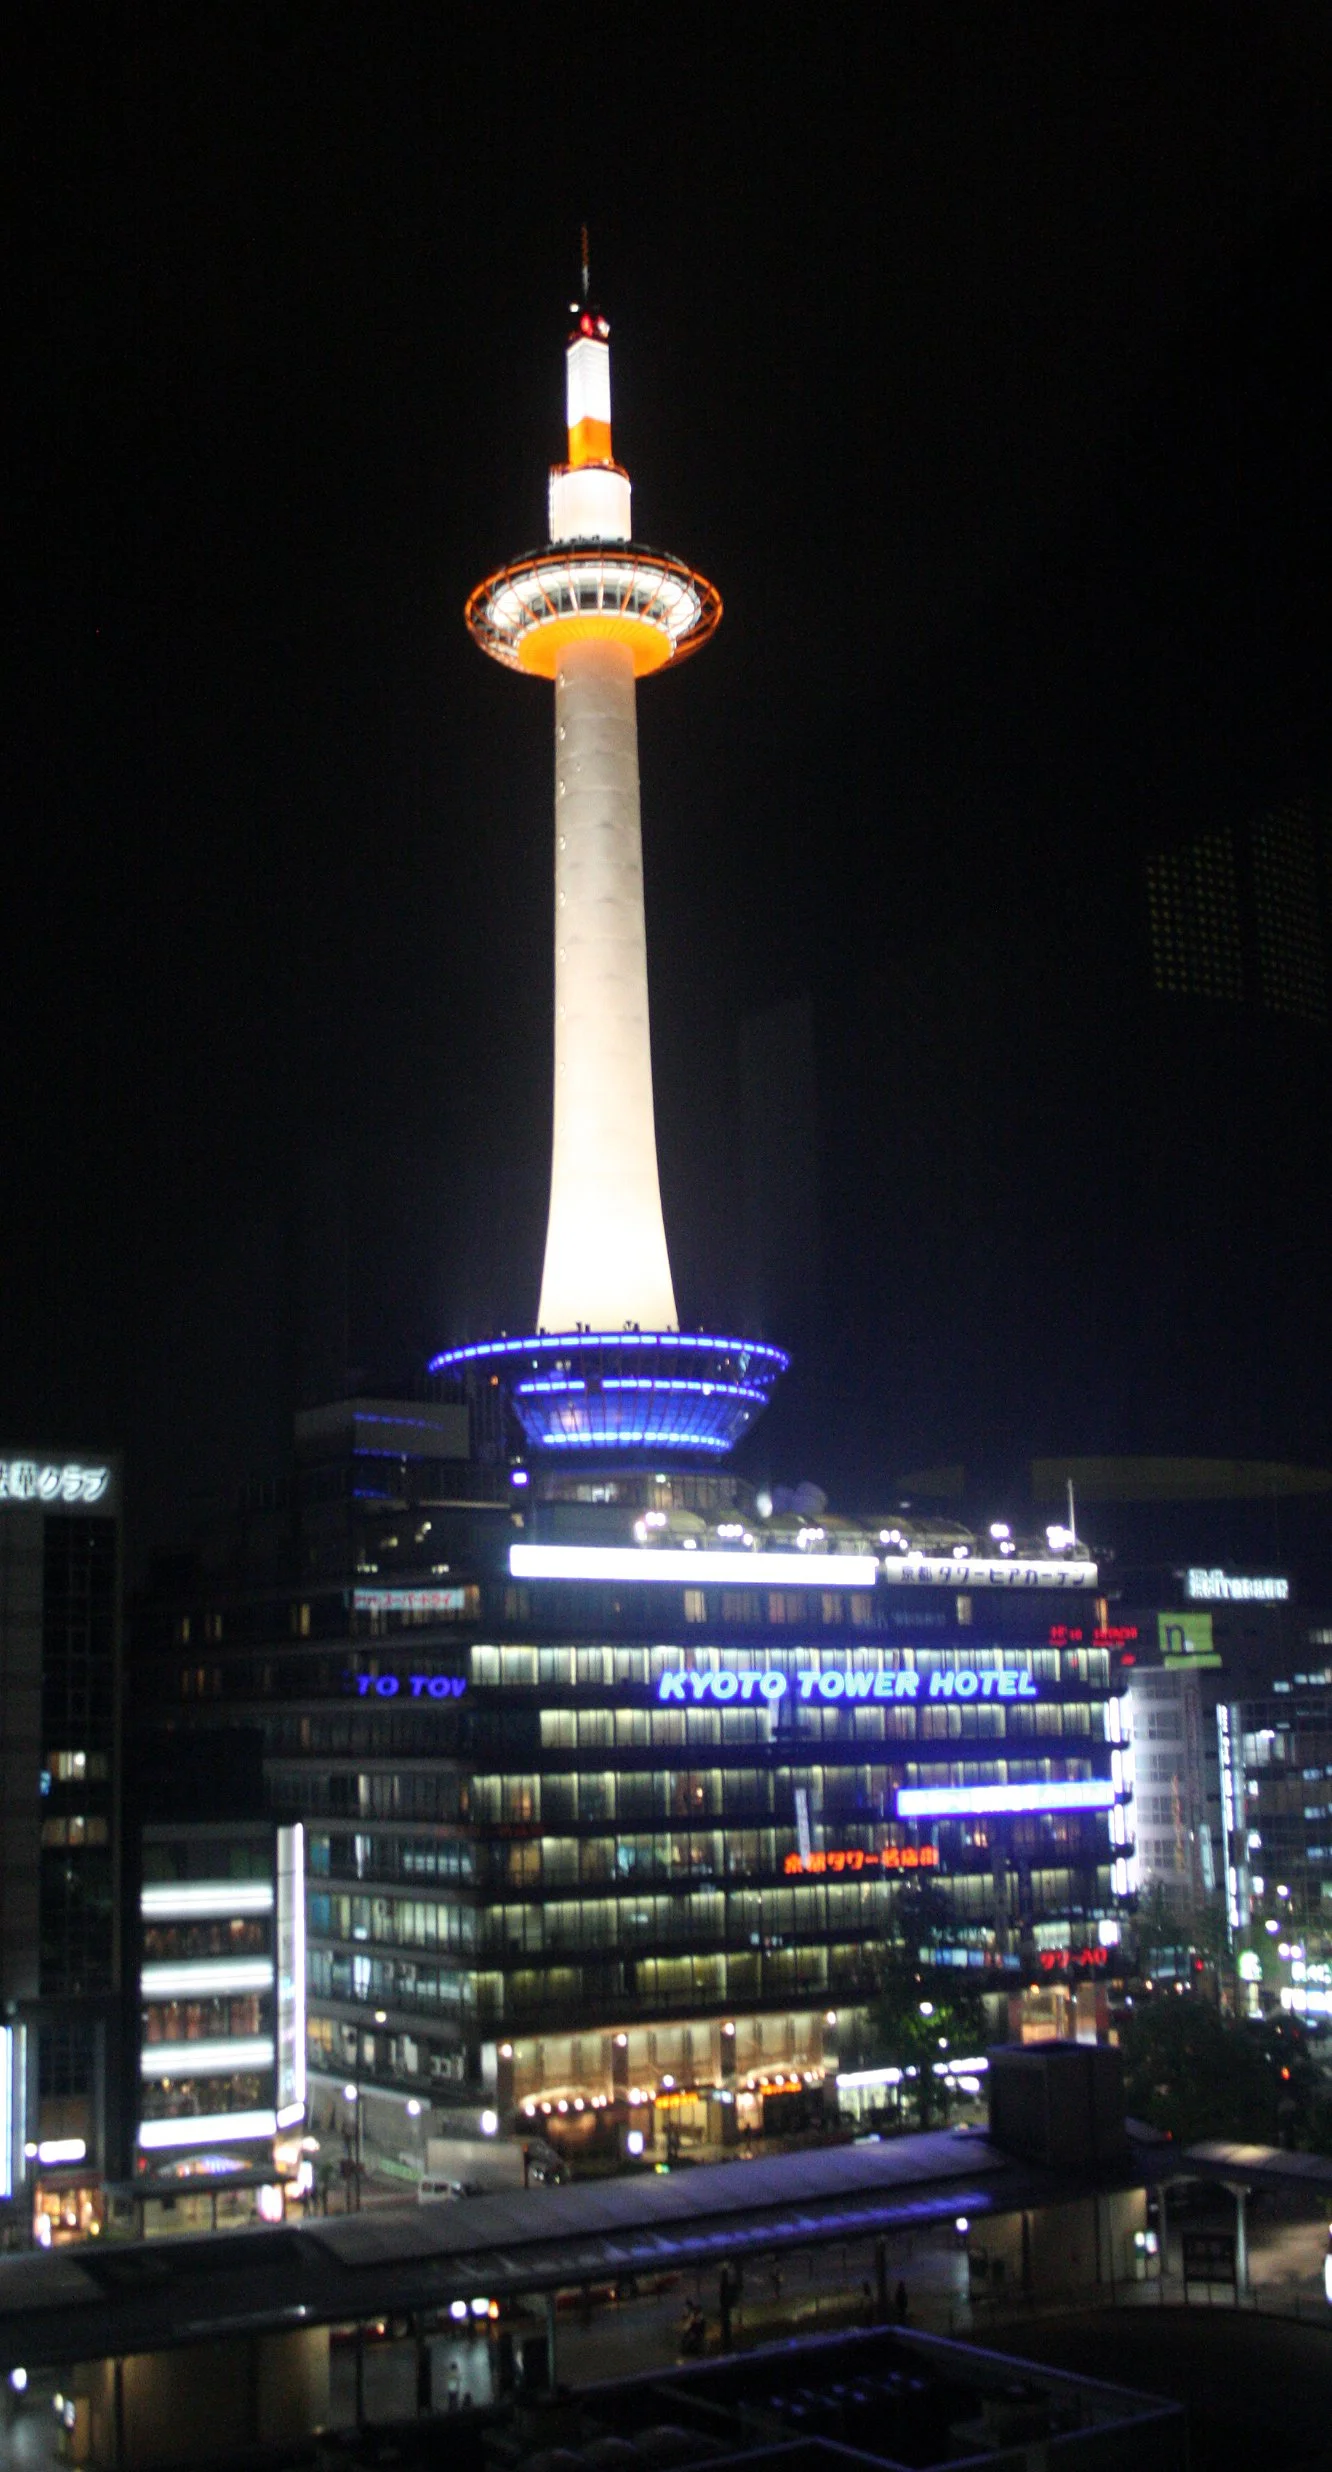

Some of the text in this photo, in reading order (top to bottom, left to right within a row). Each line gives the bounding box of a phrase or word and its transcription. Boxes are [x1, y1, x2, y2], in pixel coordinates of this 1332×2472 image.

[659, 1670, 1037, 1699] KYOTO TOWER HOTEL
